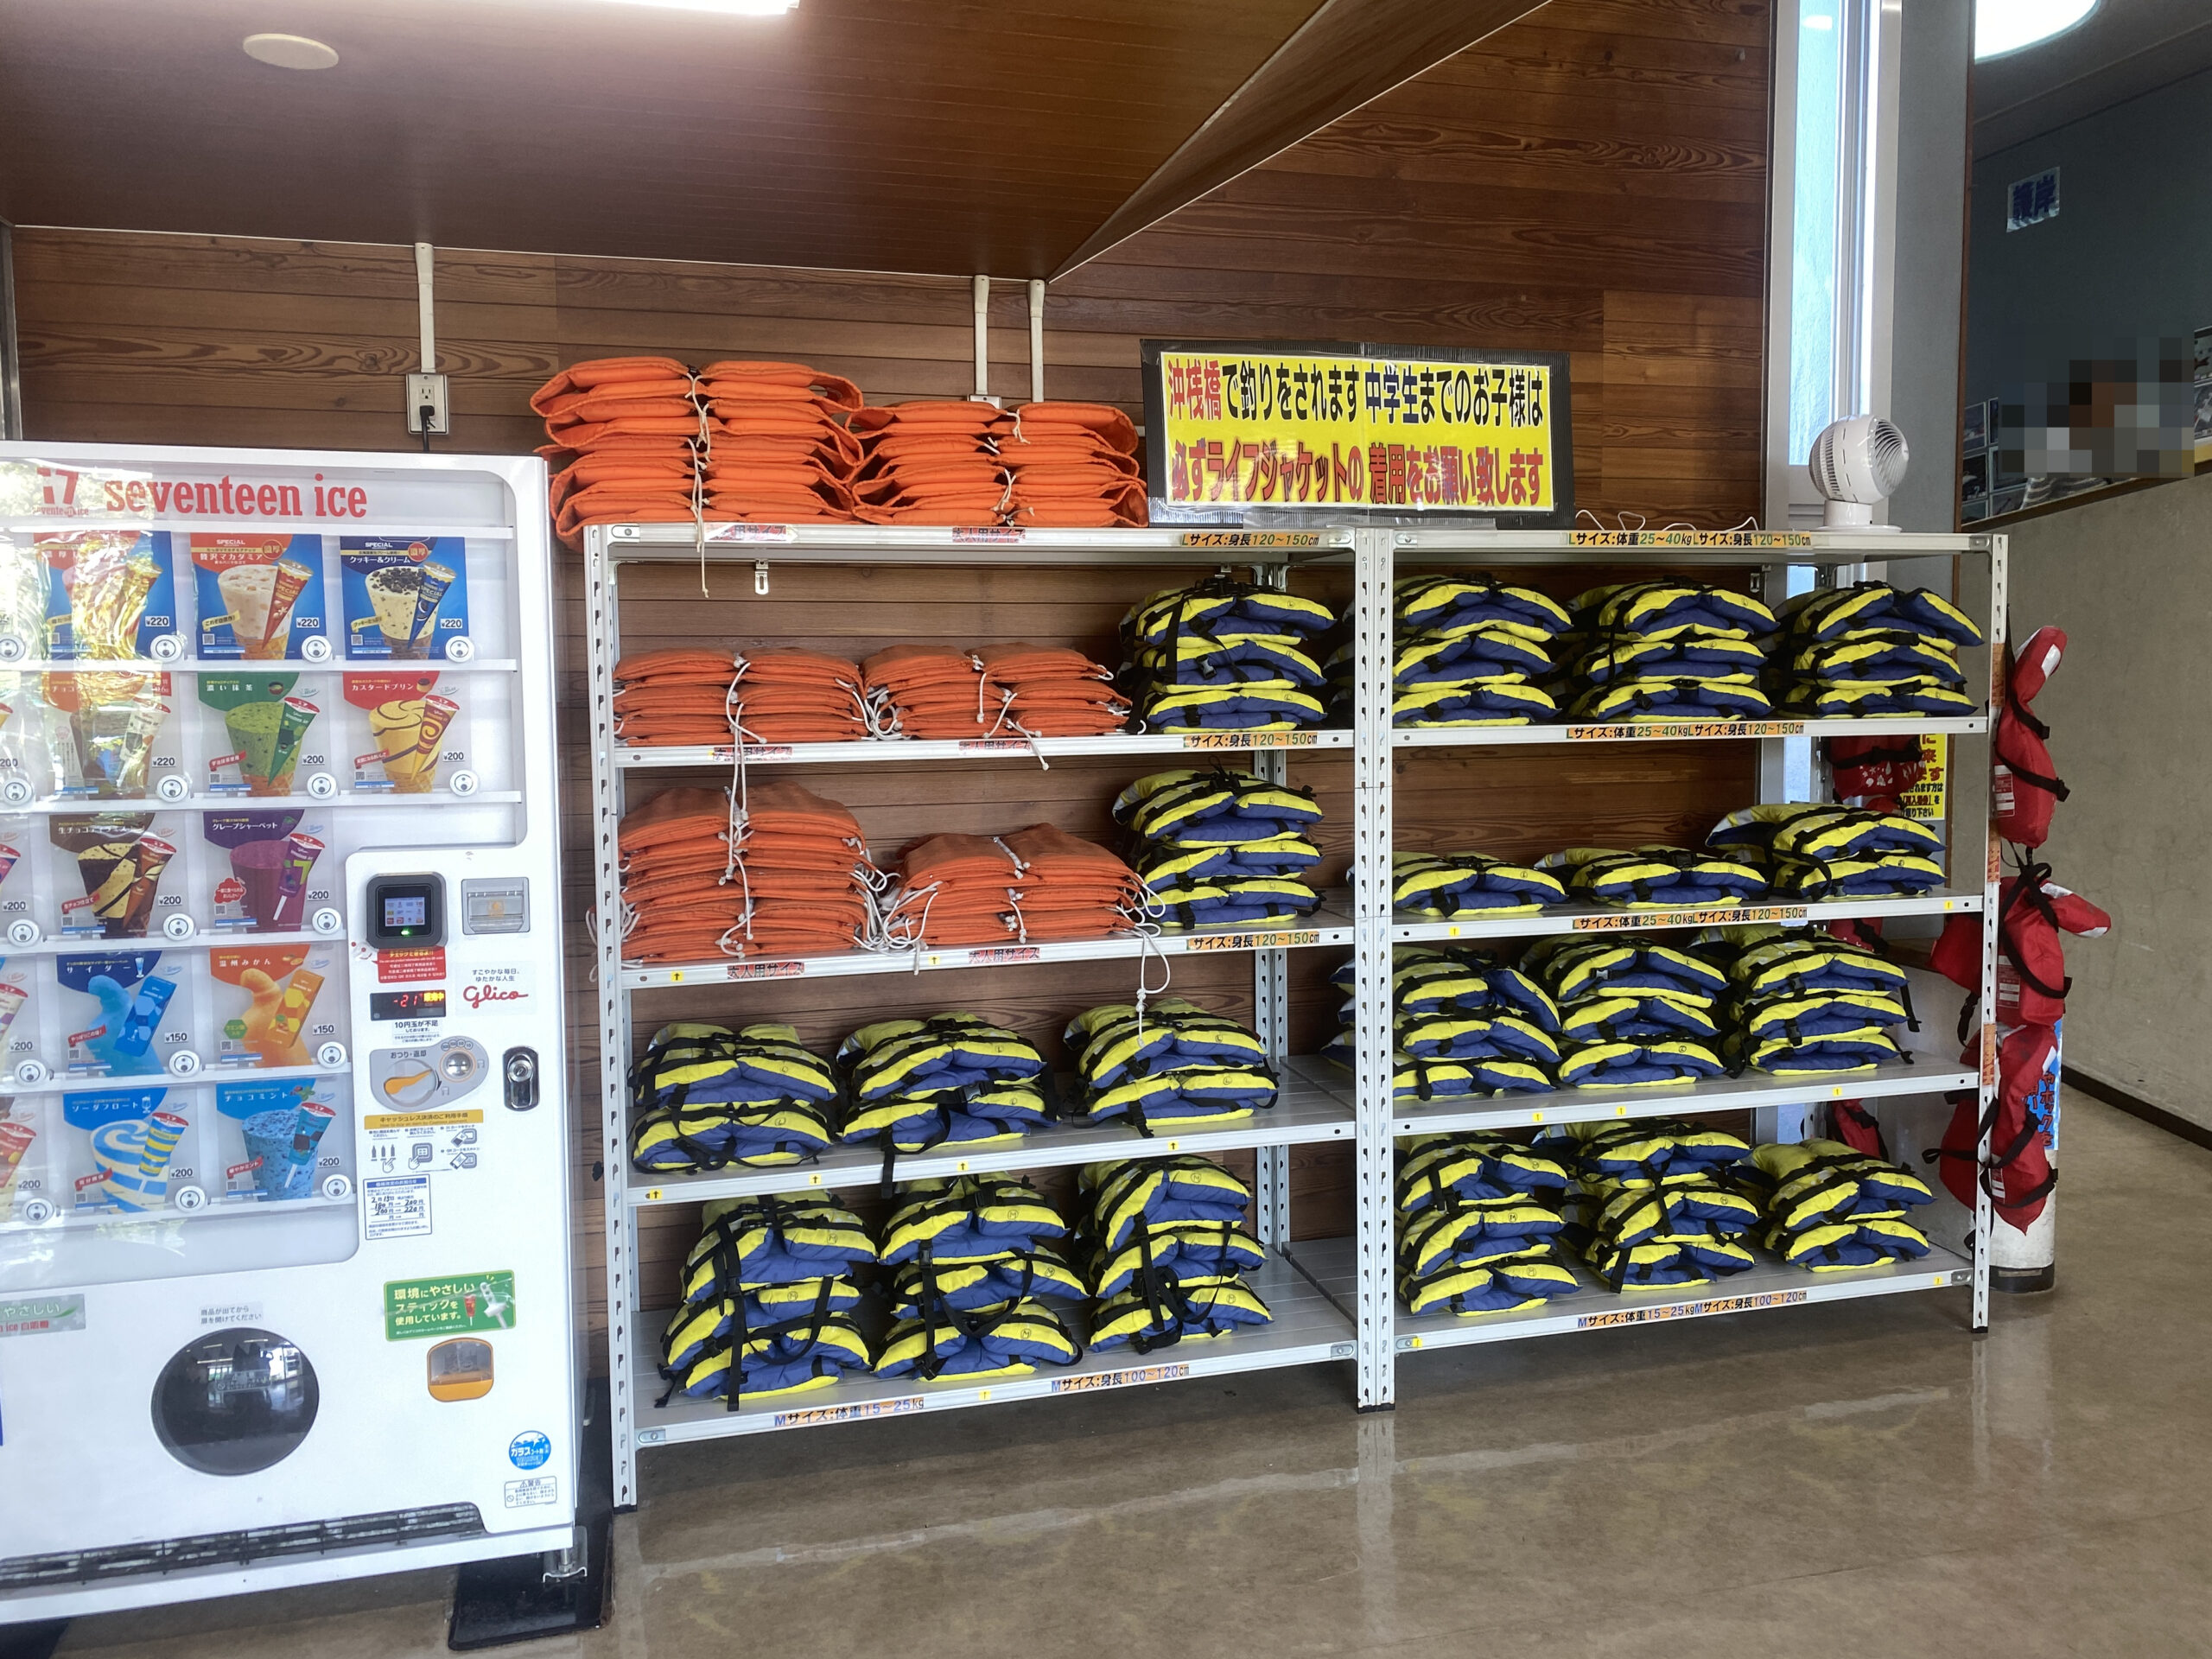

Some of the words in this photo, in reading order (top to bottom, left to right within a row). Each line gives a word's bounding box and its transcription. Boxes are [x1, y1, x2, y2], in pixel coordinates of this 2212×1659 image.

[104, 475, 302, 516] seventeen
[314, 473, 367, 518] ice
[219, 958, 270, 967] 温州みかん
[462, 984, 529, 1008] Glico
[395, 1020, 438, 1028] 10円玉が不足
[390, 1050, 427, 1058] おつり・返却
[225, 1092, 288, 1102] チョコミント
[73, 1102, 138, 1112] ソーダフロート
[394, 1283, 475, 1300] 環境にやさしい
[395, 1312, 461, 1326] 使用しています。
